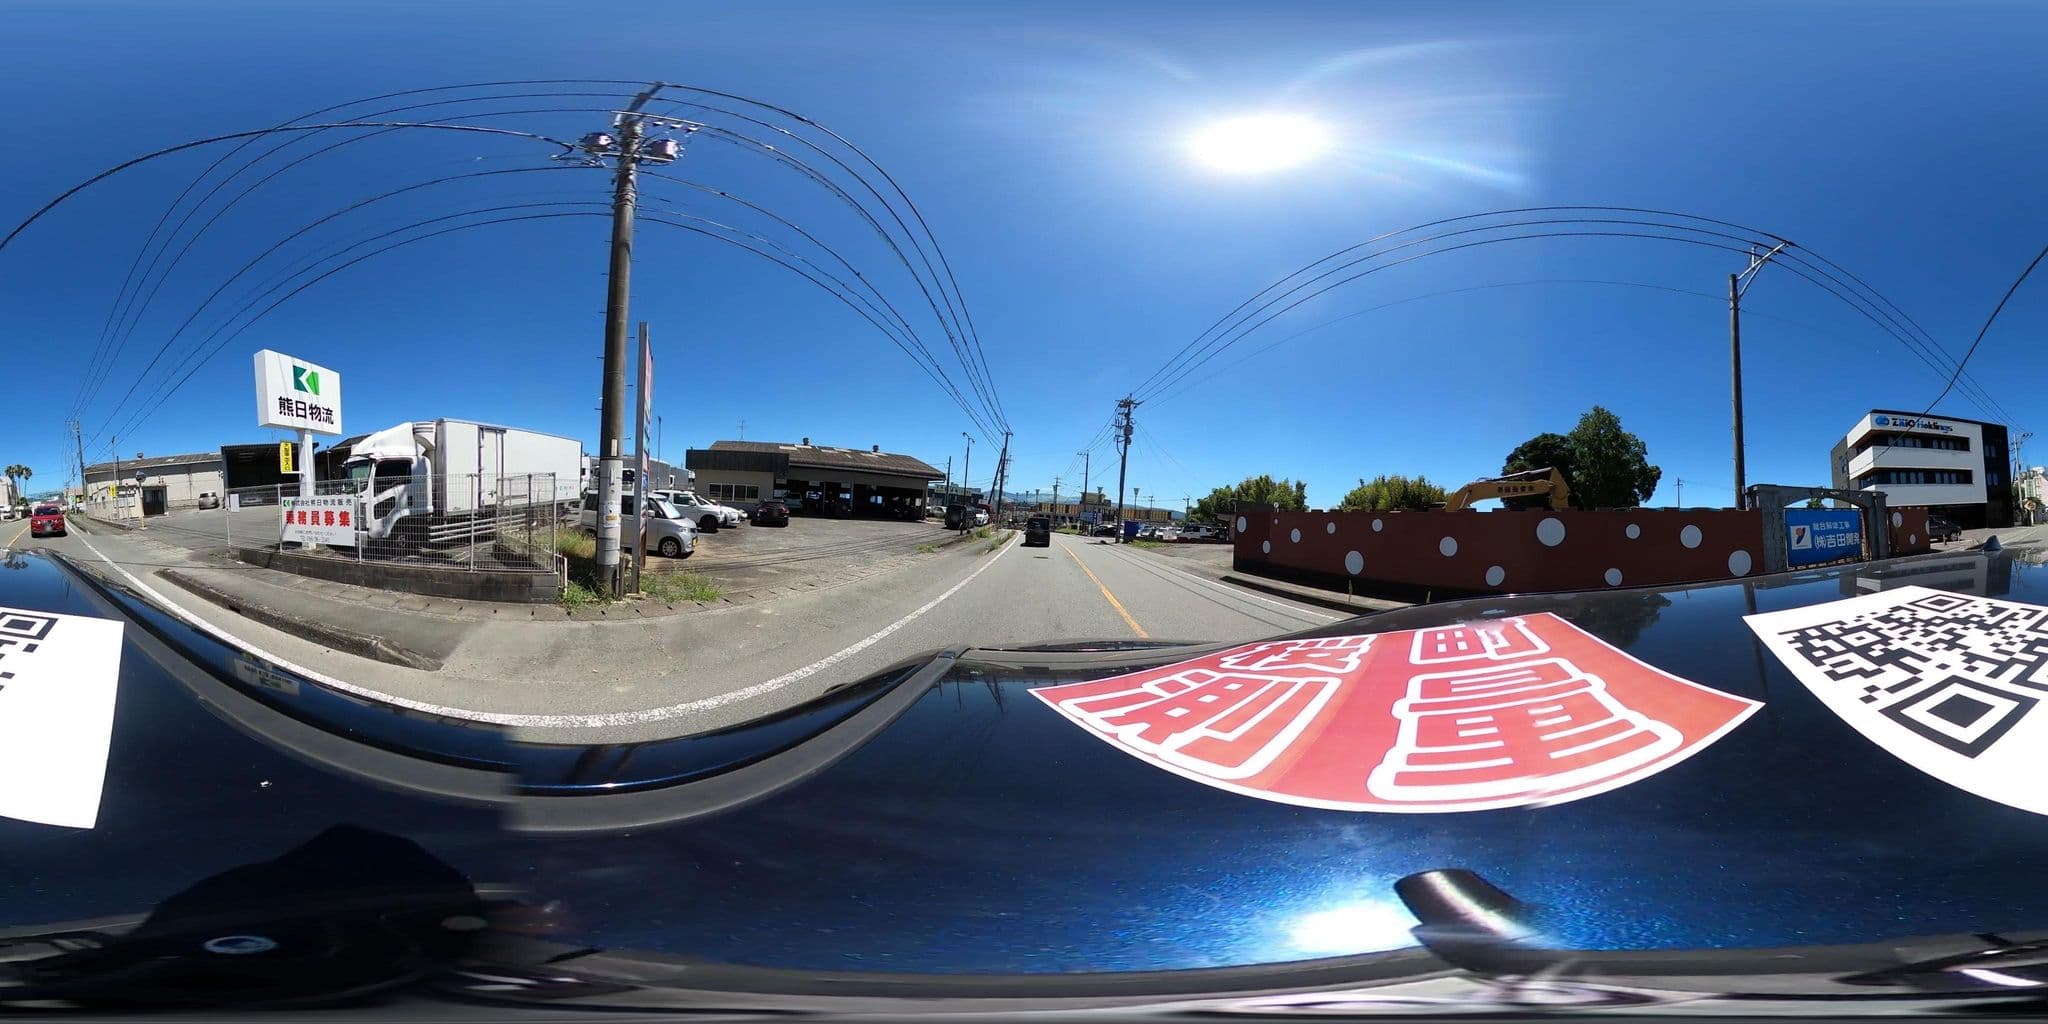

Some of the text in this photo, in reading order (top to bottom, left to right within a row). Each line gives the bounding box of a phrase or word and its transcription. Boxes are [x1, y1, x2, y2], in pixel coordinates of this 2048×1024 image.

[277, 395, 335, 425] 熊日物流
[285, 510, 351, 528] 乗務員募集
[1221, 616, 1555, 674] 桜町
[1057, 657, 1685, 805] 測量
